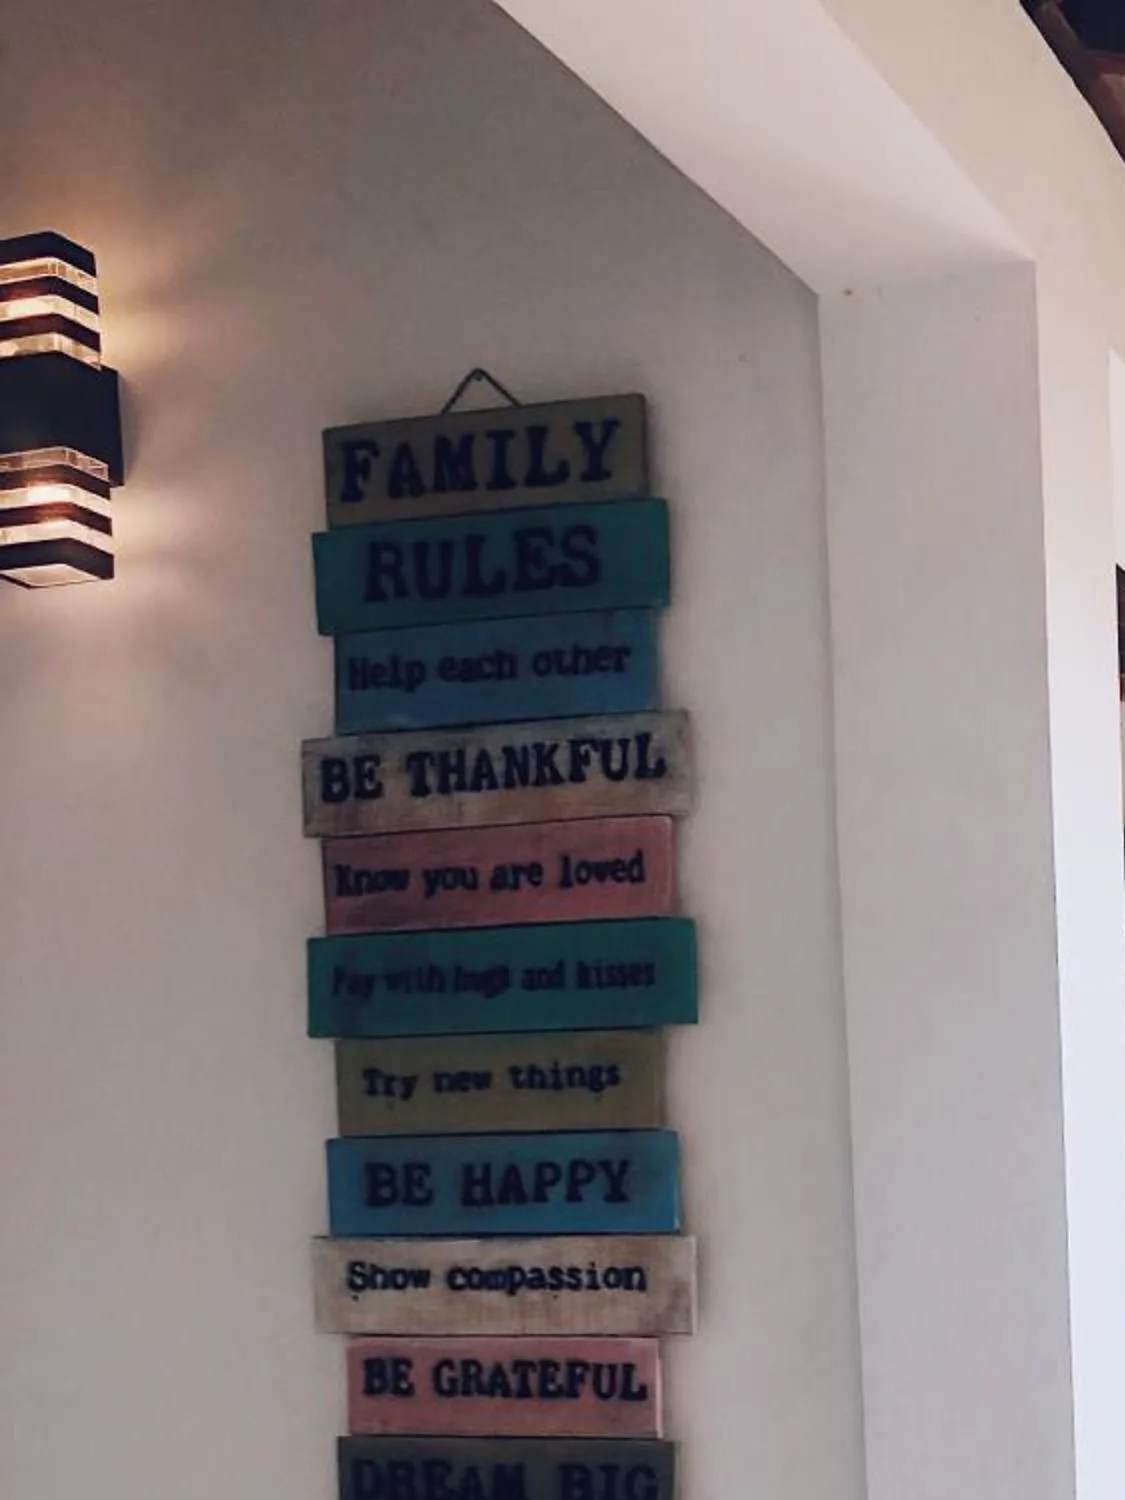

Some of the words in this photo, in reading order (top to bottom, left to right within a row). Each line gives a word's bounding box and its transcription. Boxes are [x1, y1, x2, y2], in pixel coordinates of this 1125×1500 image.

[339, 417, 621, 502] FAMILY
[364, 525, 601, 602] RULES
[347, 657, 426, 692] Help
[438, 649, 517, 684] each
[531, 643, 632, 675] other
[320, 754, 383, 803] BE
[405, 732, 668, 798] THANKFUL
[334, 863, 410, 897] Know
[422, 866, 478, 897] you
[490, 863, 543, 889] are
[559, 850, 646, 887] loved
[521, 960, 565, 990] and
[362, 1067, 419, 1100] Try
[434, 1069, 492, 1092] new
[508, 1060, 621, 1092] things
[364, 1161, 434, 1207] BE
[461, 1159, 633, 1206] HAPPY
[347, 1260, 431, 1292] Show
[447, 1260, 647, 1296] compassion
[363, 1358, 415, 1396] BE
[432, 1359, 648, 1401] GRATEFUL
